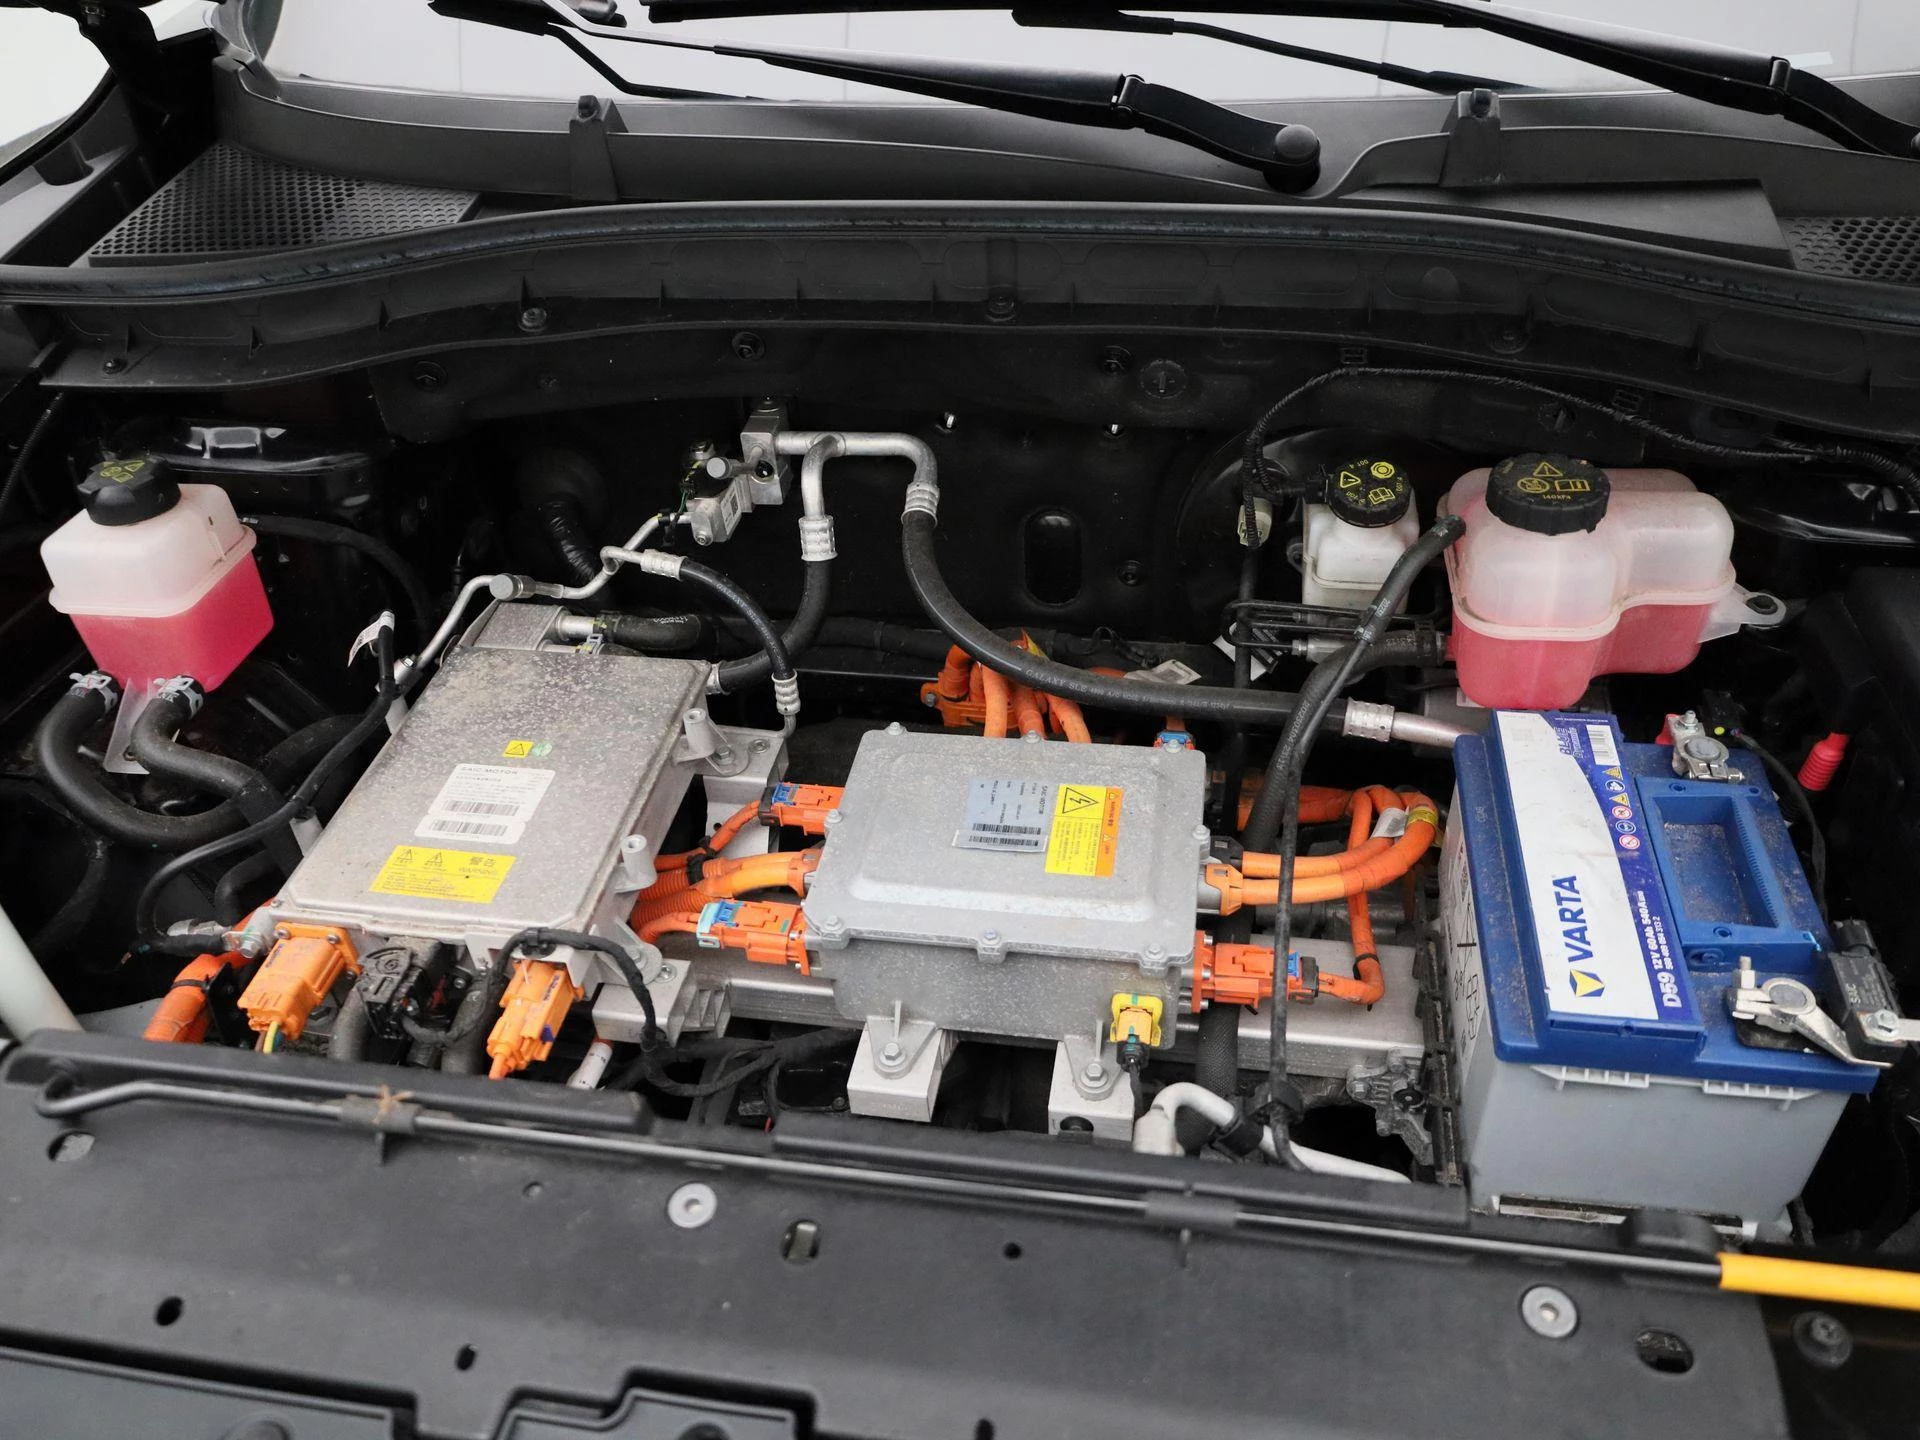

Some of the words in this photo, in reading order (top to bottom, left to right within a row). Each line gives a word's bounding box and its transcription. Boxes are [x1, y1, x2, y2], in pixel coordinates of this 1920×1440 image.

[1024, 668, 1065, 686] GALAXY
[1068, 680, 1087, 692] SLE
[1554, 727, 1572, 755] BLUE
[1553, 875, 1592, 963] VARTA
[1645, 926, 1658, 951] 60Ah
[1650, 951, 1663, 970] 12V
[1657, 971, 1682, 1008] D59
